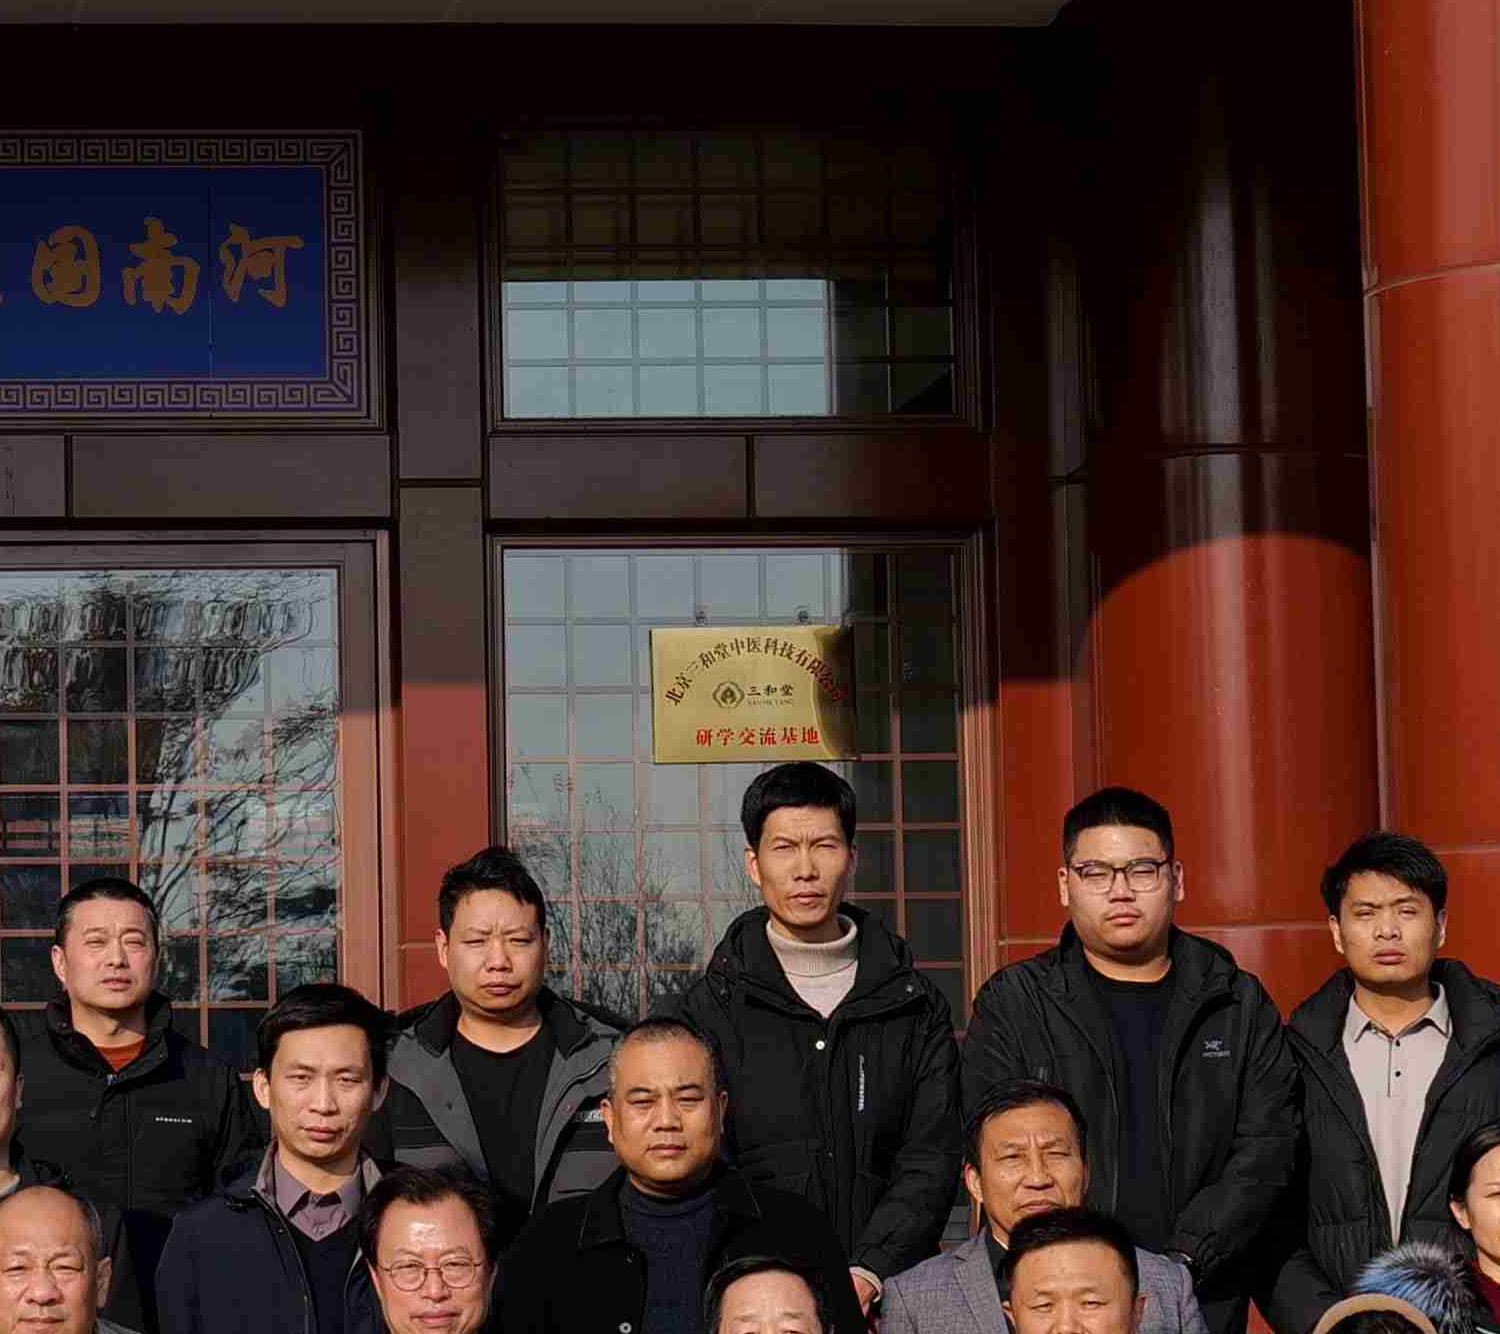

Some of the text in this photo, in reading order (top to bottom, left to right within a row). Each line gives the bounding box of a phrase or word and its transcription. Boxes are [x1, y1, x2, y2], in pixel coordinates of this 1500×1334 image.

[696, 726, 820, 746] 研学交流基地
